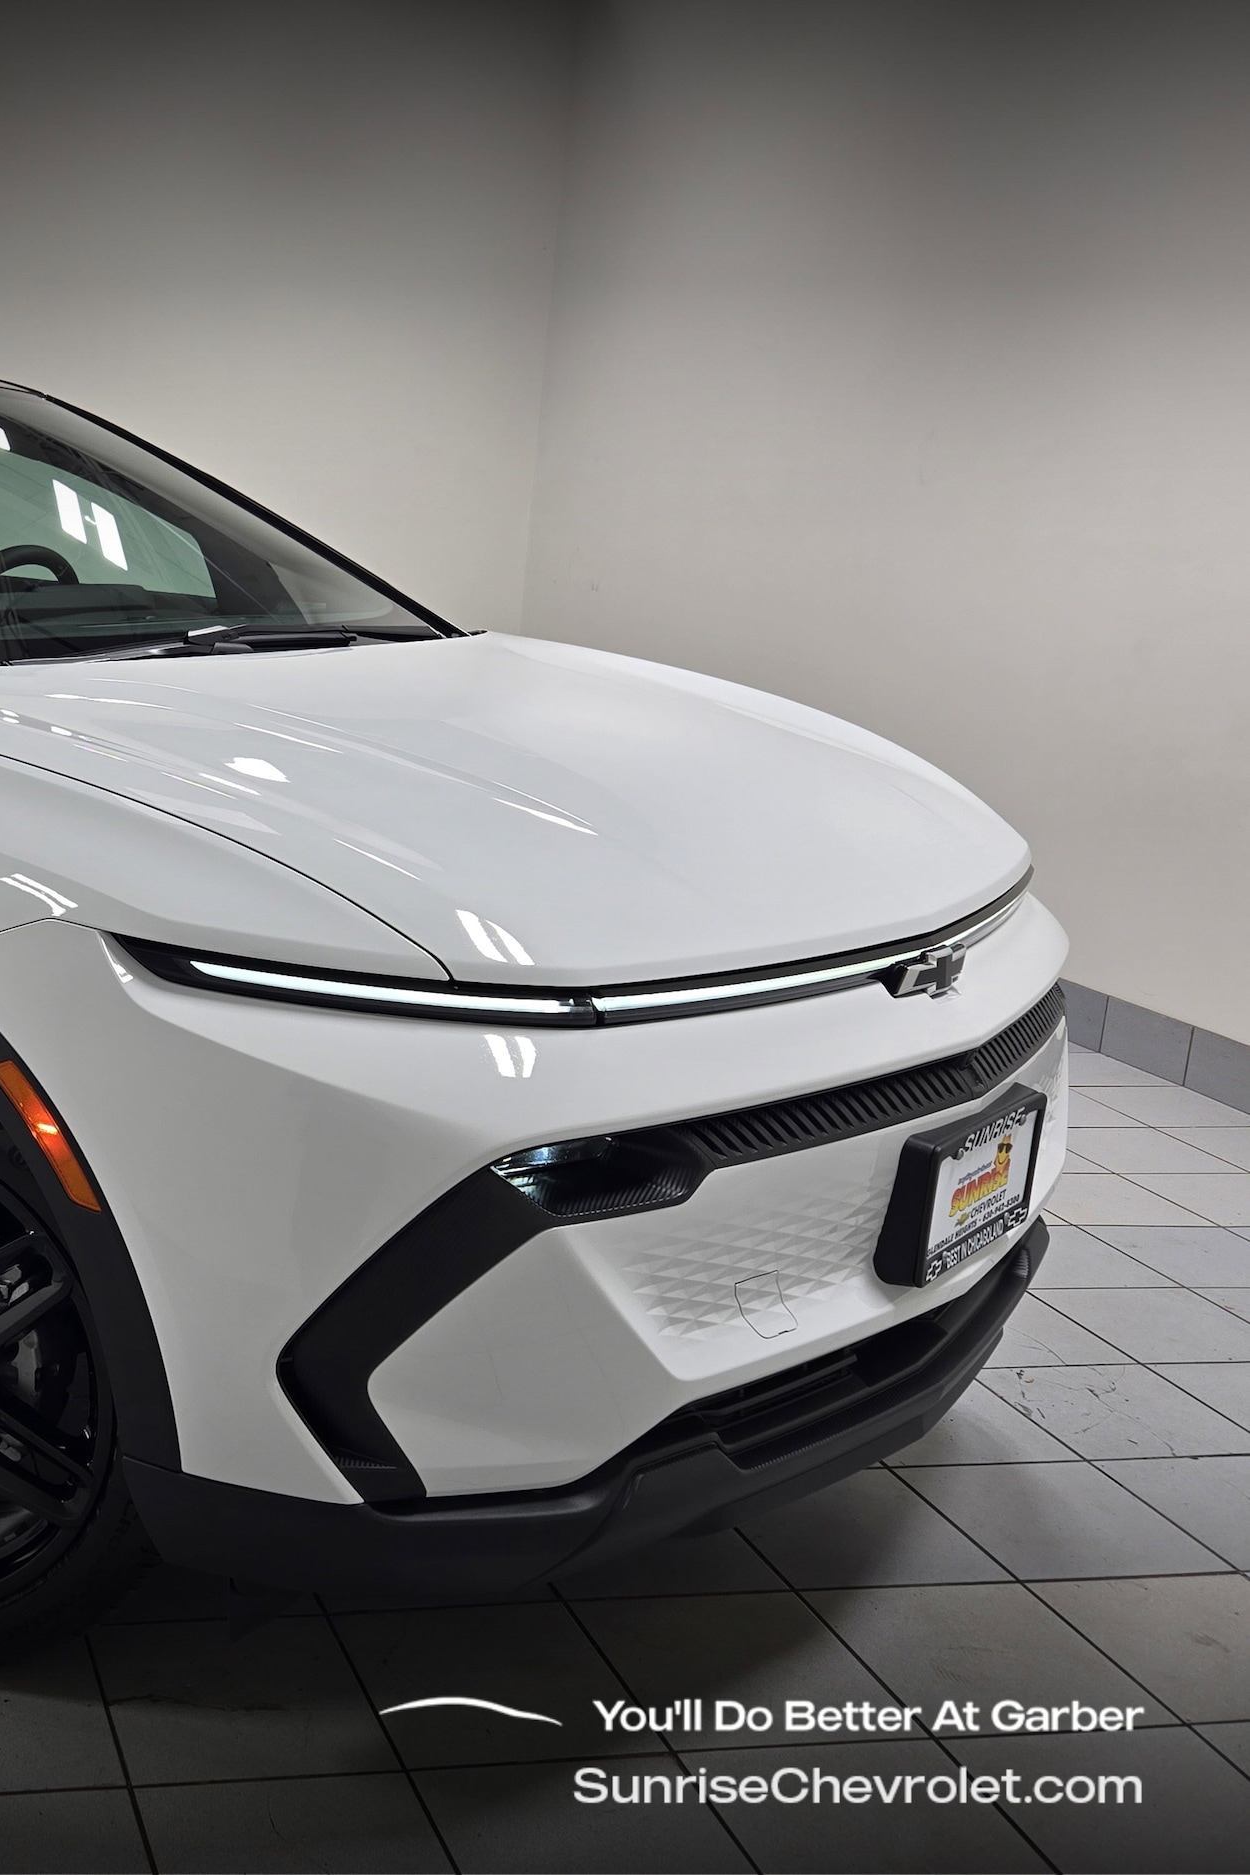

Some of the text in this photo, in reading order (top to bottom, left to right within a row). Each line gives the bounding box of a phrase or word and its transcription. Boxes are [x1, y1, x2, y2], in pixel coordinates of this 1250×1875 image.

[964, 1106, 1026, 1153] SUNRISE
[948, 1165, 1011, 1217] SUNRISE
[970, 1188, 1007, 1218] CHEVROLET
[955, 1218, 978, 1239] HEIGHTS
[946, 1245, 961, 1269] BEST
[961, 1240, 968, 1260] IN
